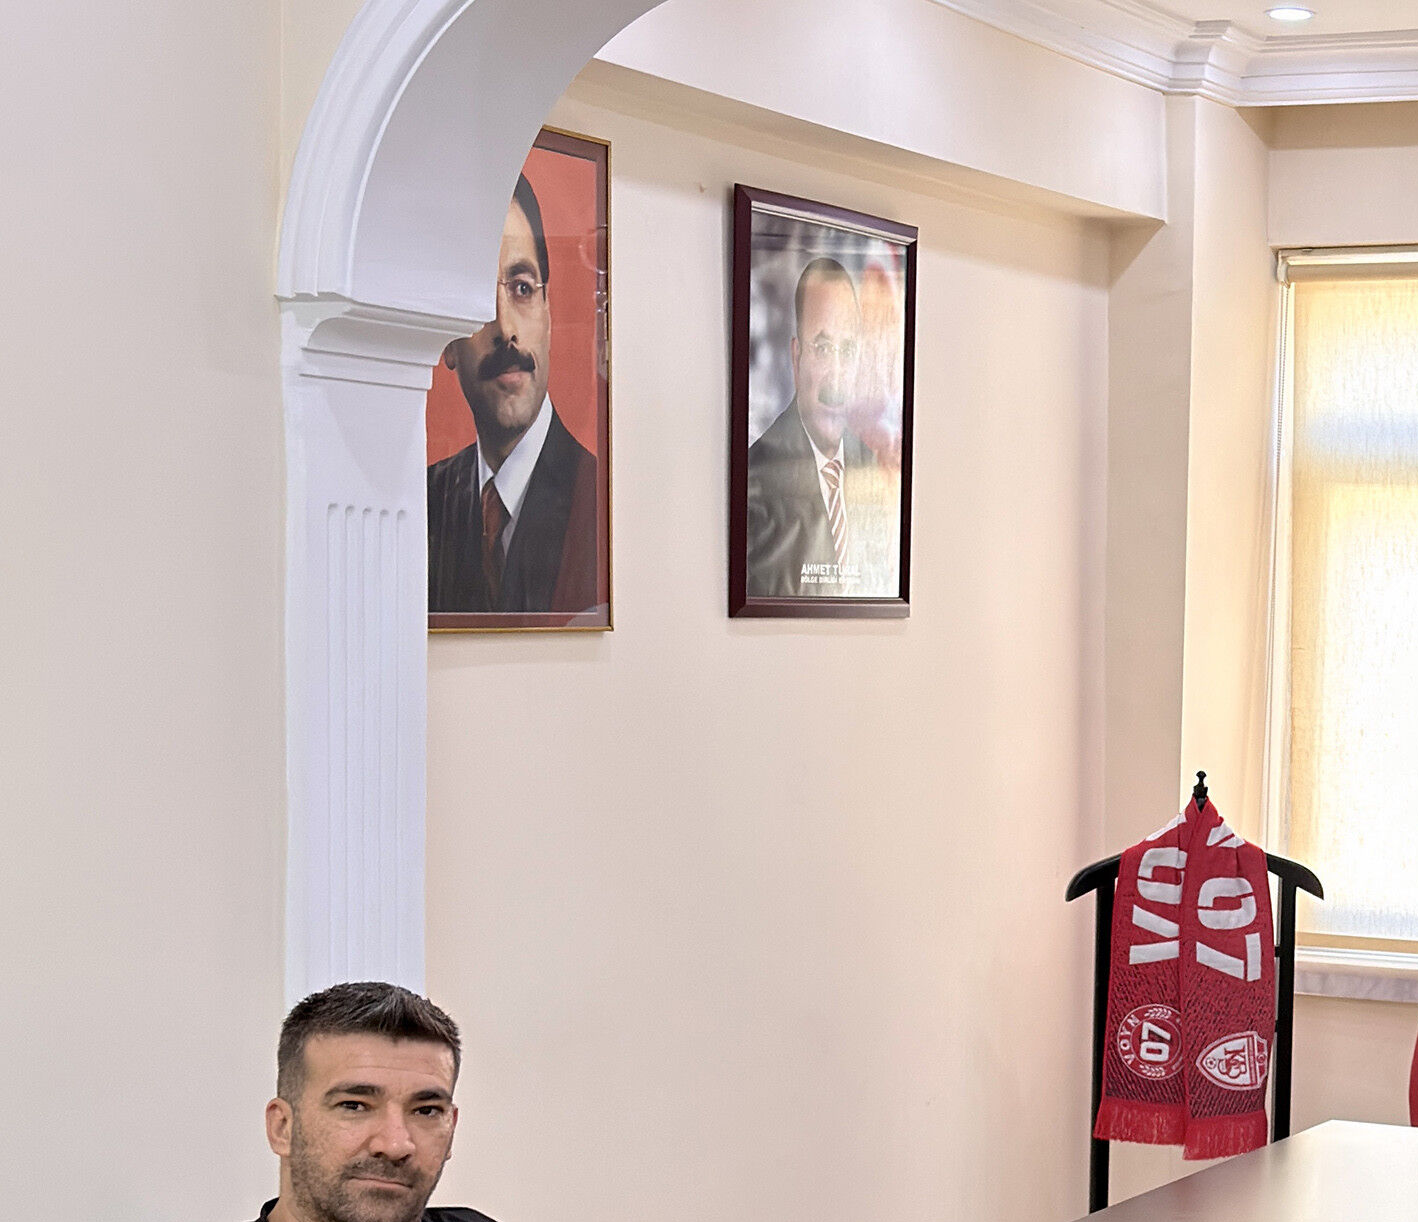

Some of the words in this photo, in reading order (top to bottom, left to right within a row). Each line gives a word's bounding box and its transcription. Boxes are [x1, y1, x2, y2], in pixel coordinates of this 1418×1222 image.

[801, 563, 830, 576] AHMET
[1195, 876, 1262, 982] 07
[1139, 1021, 1171, 1062] 07
